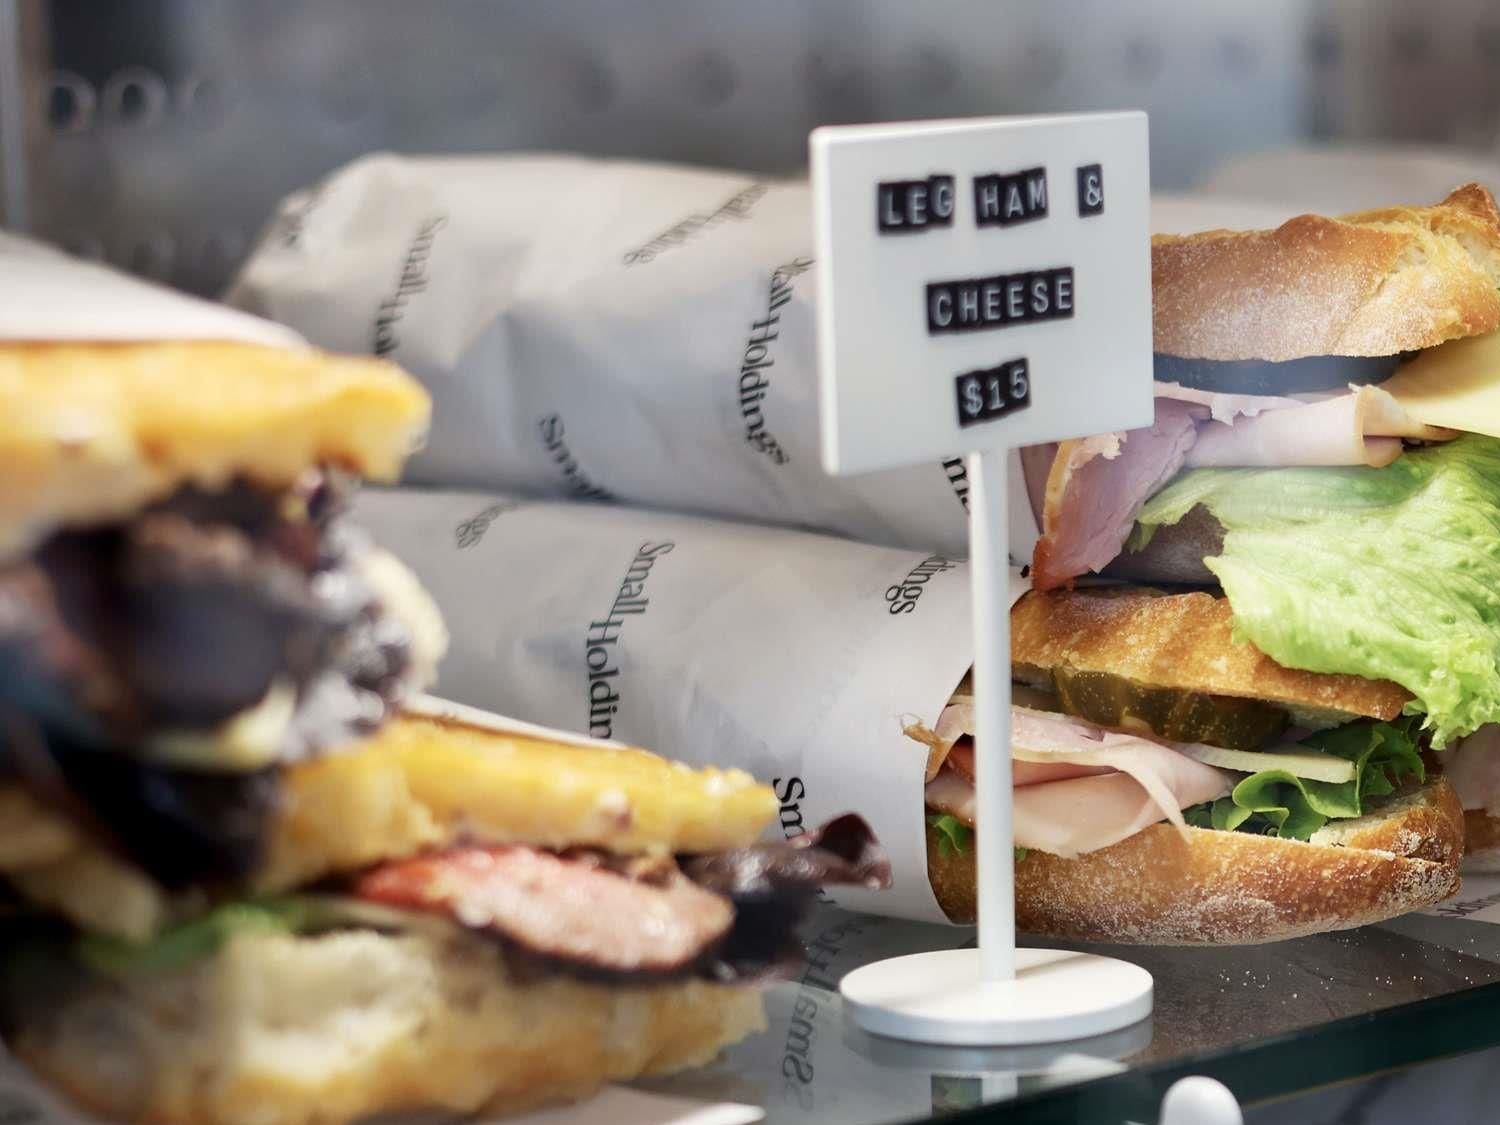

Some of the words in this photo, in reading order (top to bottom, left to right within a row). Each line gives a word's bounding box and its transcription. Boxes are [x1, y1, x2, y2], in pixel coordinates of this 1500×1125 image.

[885, 183, 954, 226] LEG
[981, 173, 1047, 219] HAM
[1086, 173, 1104, 208] &
[932, 276, 1073, 328] CHEESE
[963, 365, 1030, 418] $15
[884, 552, 957, 616] dings
[584, 617, 625, 741] Holdin
